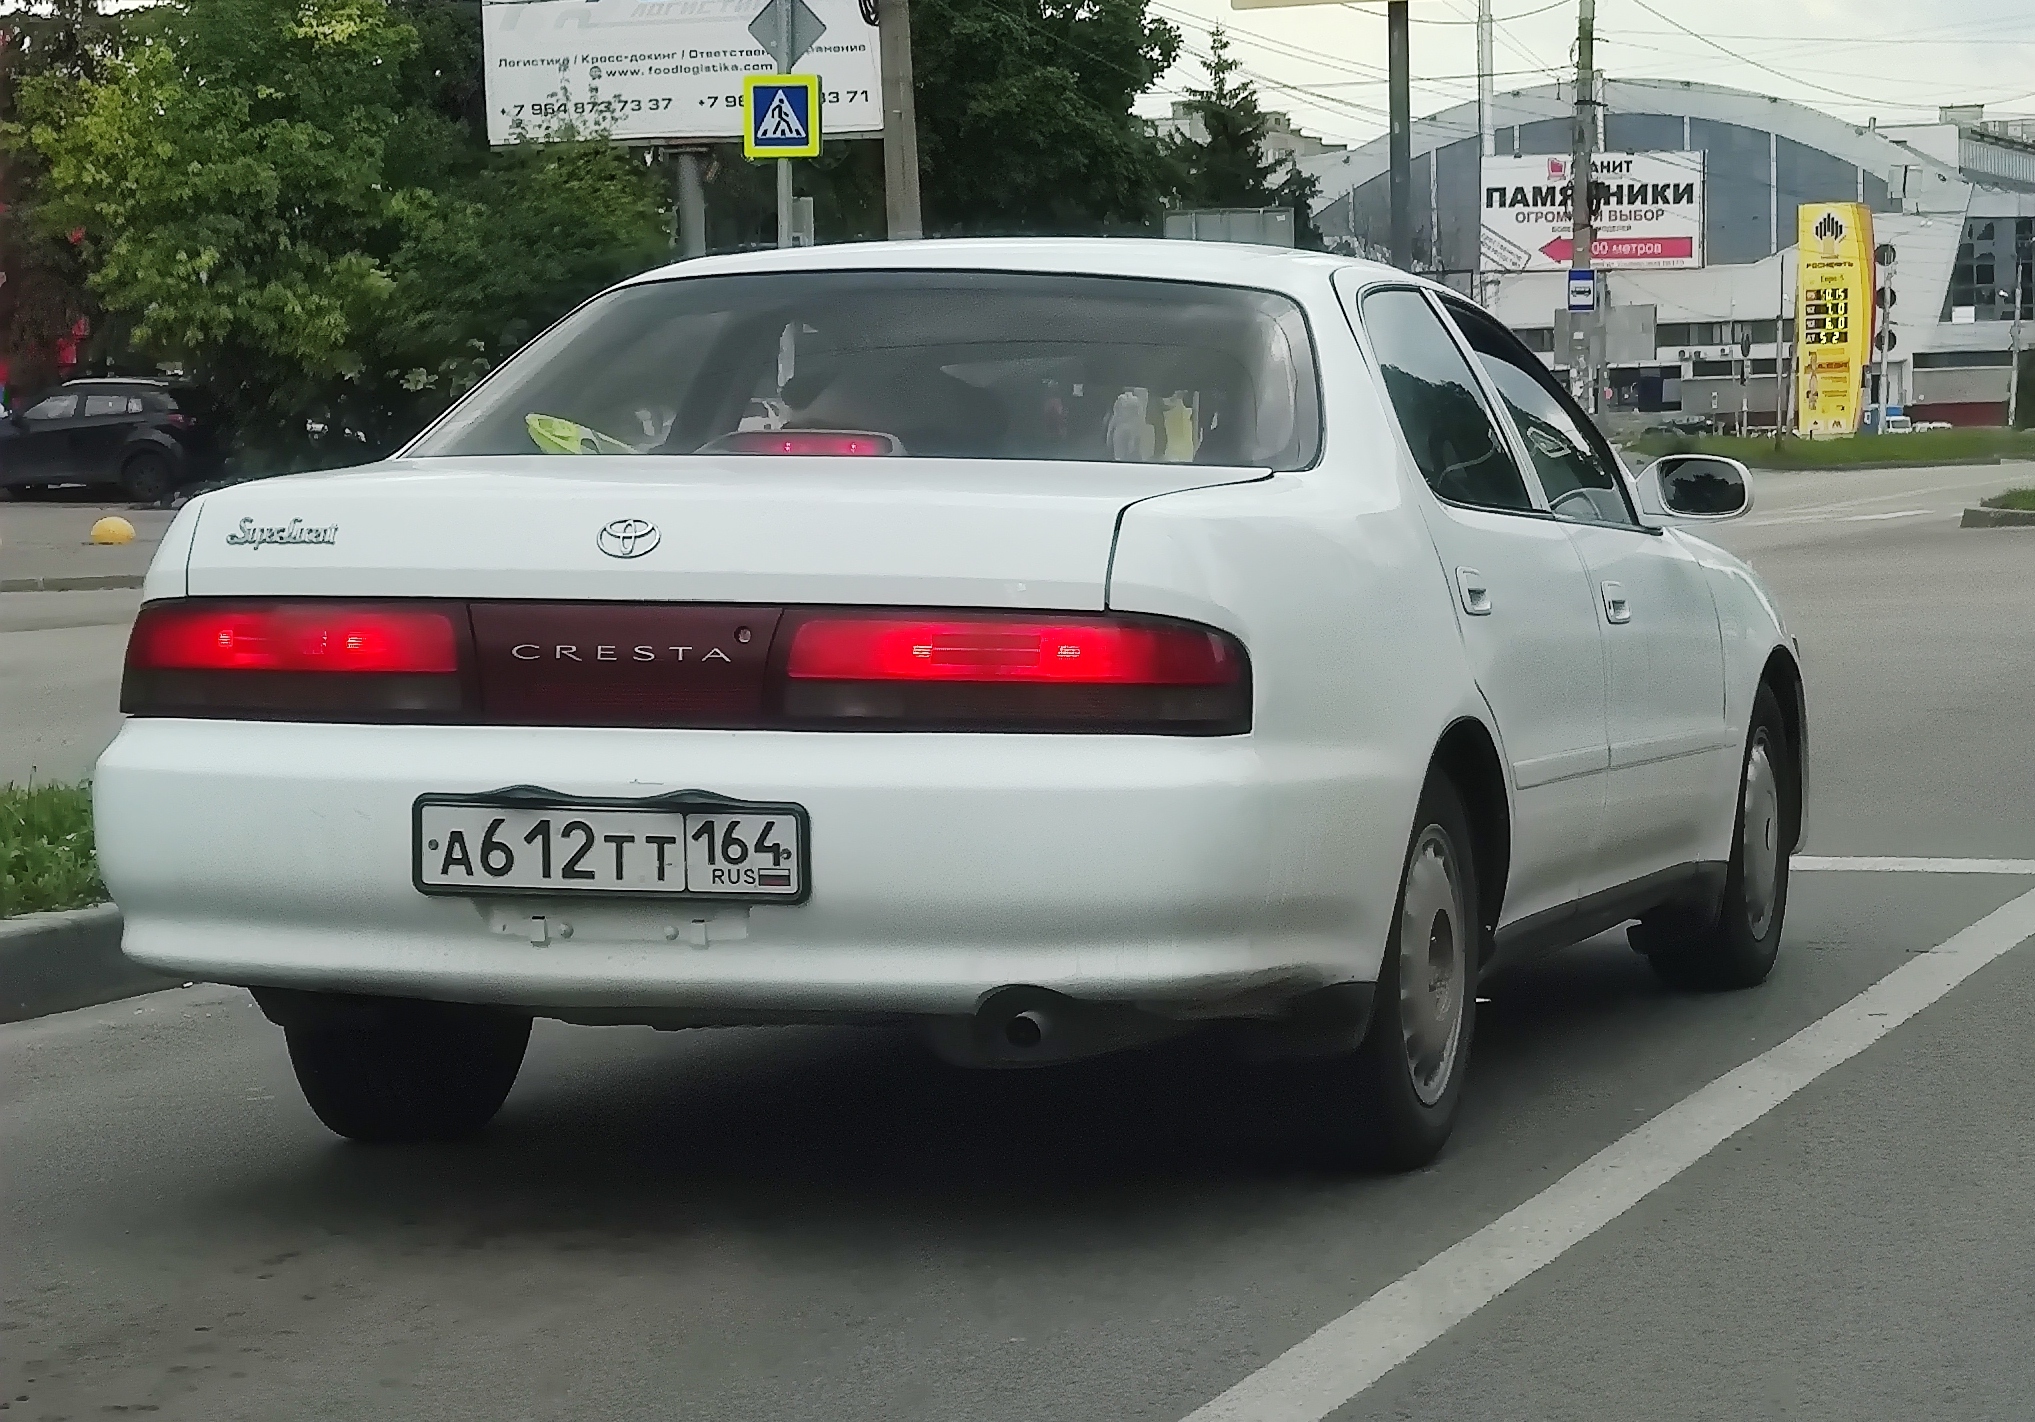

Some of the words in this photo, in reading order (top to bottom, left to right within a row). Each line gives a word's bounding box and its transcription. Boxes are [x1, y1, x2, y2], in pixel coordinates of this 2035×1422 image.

[498, 56, 570, 68] Логистика
[581, 51, 678, 65] Кросс-докинг
[689, 49, 769, 59] Ответствен
[846, 90, 869, 102] 71
[573, 101, 613, 114] 873
[617, 99, 643, 112] 73
[648, 98, 673, 110] 37
[1485, 183, 1694, 208] ПАМЯНИКИ
[1608, 209, 1665, 222] ВЫБОР
[511, 644, 732, 662] CRESTA
[440, 818, 677, 882] А612ТТ
[691, 820, 781, 867] 164
[712, 868, 756, 885] RUS
